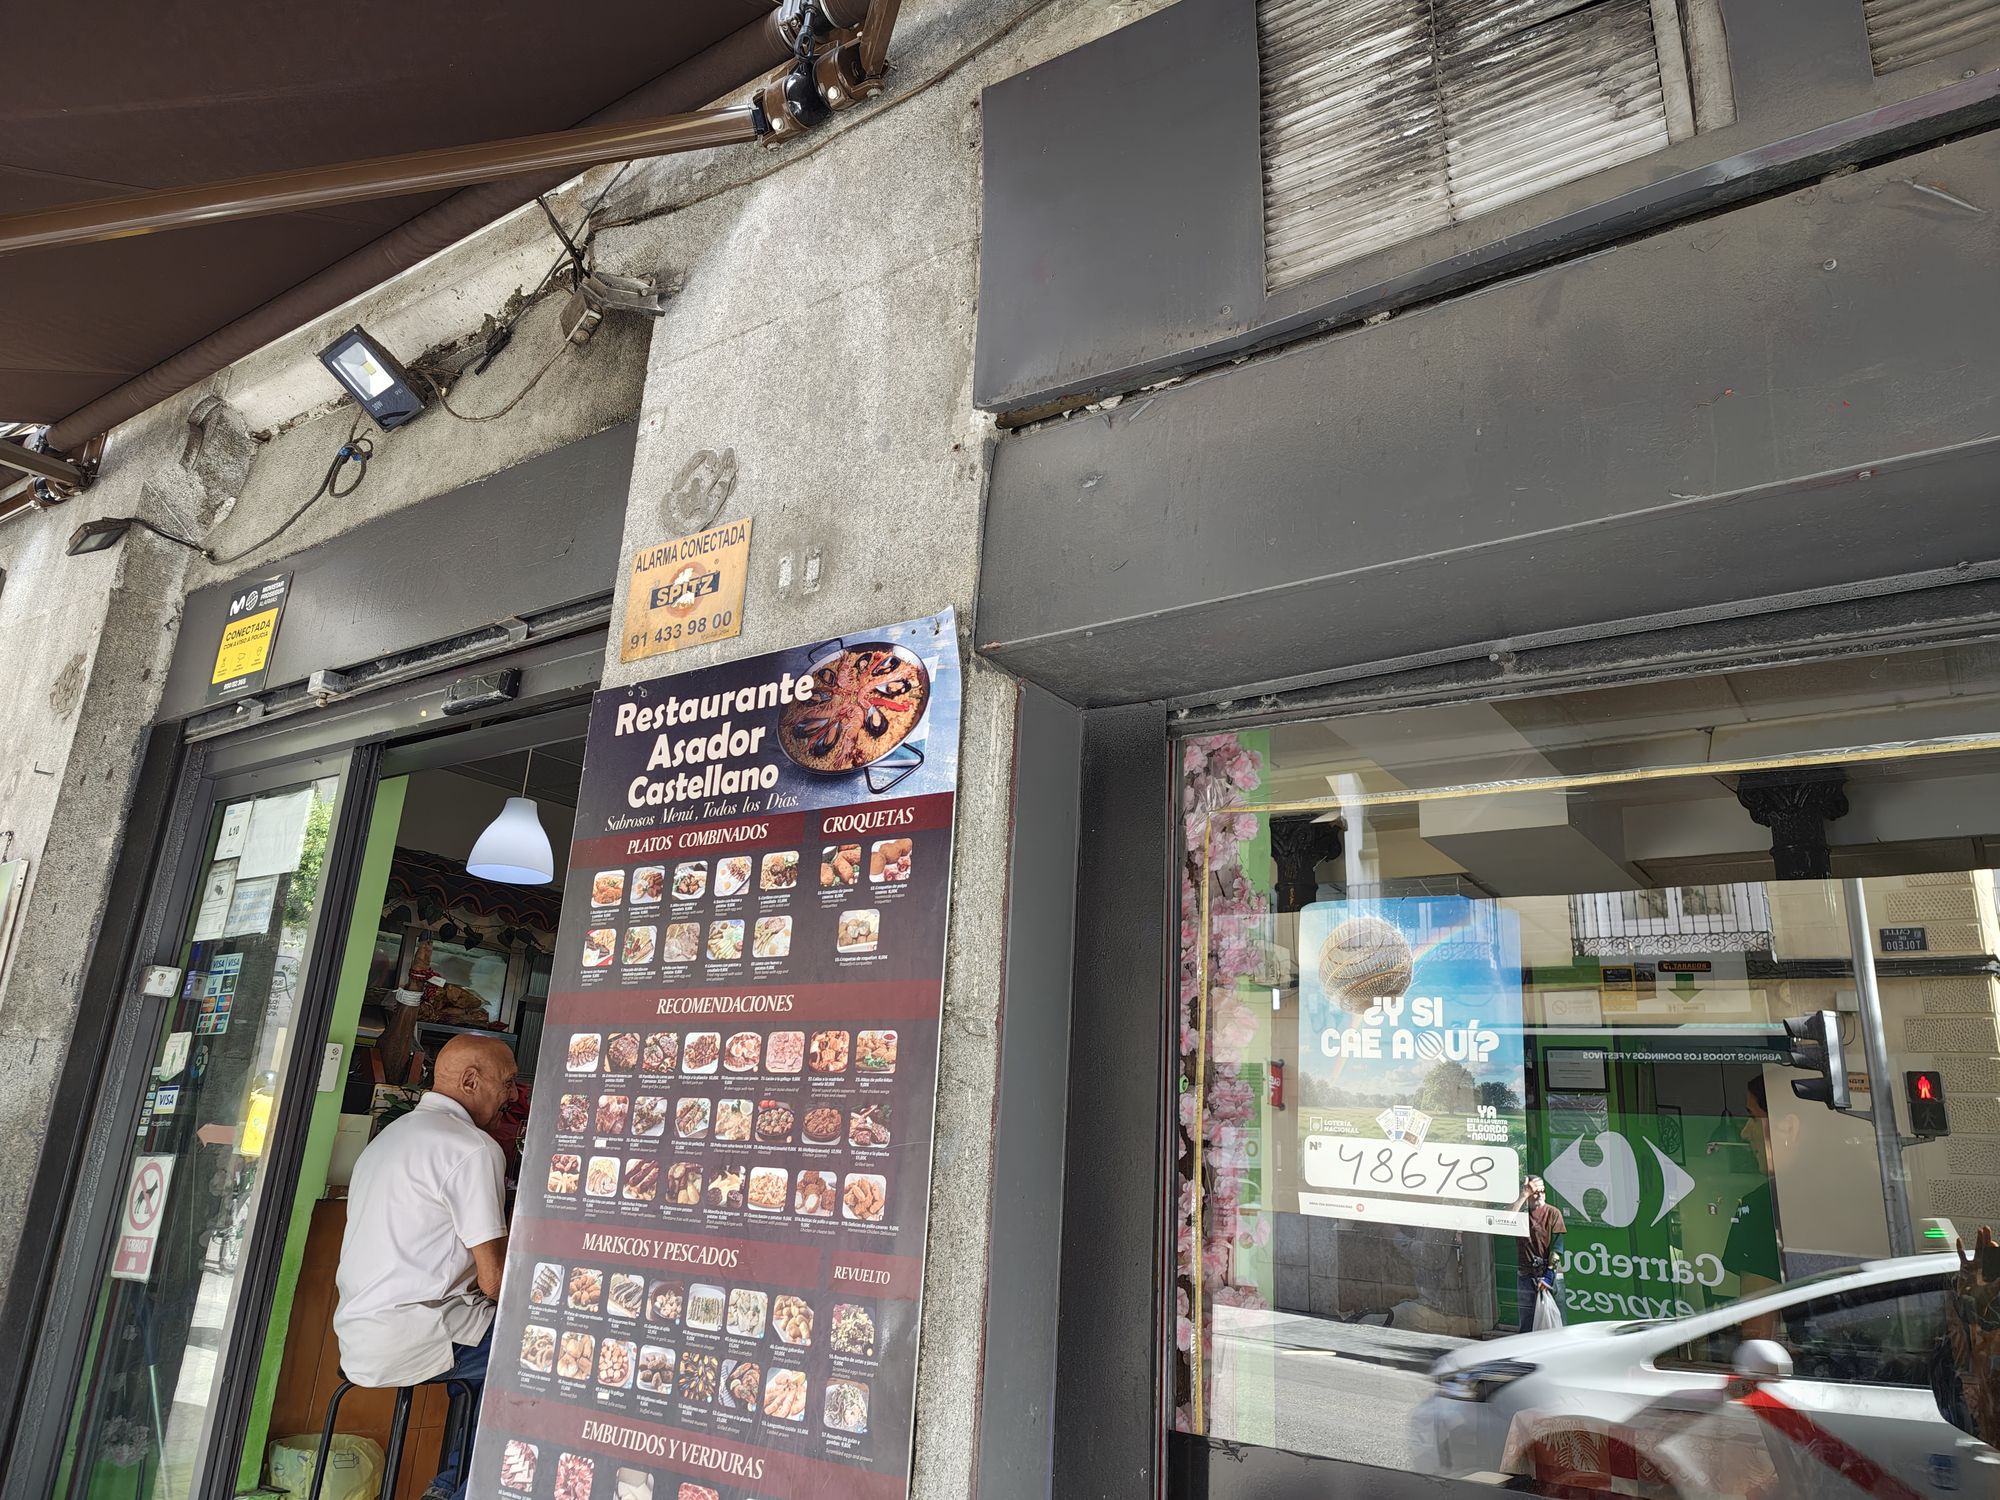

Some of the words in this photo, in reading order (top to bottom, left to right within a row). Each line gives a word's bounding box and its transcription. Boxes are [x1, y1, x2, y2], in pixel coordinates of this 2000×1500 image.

[635, 545, 677, 574] ALARMA
[680, 524, 746, 560] CONECTADA
[656, 574, 714, 606] SPITZ
[226, 619, 271, 641] CONECTADA
[630, 632, 647, 650] 91
[654, 624, 682, 643] 433
[688, 617, 706, 636] 98
[712, 610, 732, 628] 00
[614, 672, 814, 736] Restaurante
[646, 721, 766, 771] Asador
[628, 763, 779, 808] Castellano
[605, 811, 655, 832] Sabrosos
[703, 801, 737, 819] Todos
[742, 796, 760, 814] los
[822, 807, 914, 834] CROQUETAS
[626, 834, 672, 856] PLATOS
[678, 823, 769, 848] COMBINADOS
[656, 994, 794, 1015] RECOMENDACIONES
[1364, 996, 1406, 1027] ¿Y
[1412, 996, 1443, 1028] SI
[1321, 1028, 1382, 1058] CAE
[1392, 1020, 1500, 1063] AQUÍ?
[160, 1094, 174, 1105] VISA
[1477, 1105, 1496, 1118] YA
[1323, 1119, 1352, 1128] LOTERÍA
[1323, 1126, 1360, 1134] NACIONAL
[1472, 1133, 1508, 1142] NAVIDAD
[582, 1232, 650, 1258] MARISCOS
[652, 1240, 663, 1259] Y
[663, 1240, 739, 1268] PESCADOS
[834, 1264, 890, 1286] REVUELTO
[582, 1420, 664, 1458] EMBUTIDOS
[668, 1438, 681, 1459] Y
[680, 1440, 764, 1480] VERDURAS
